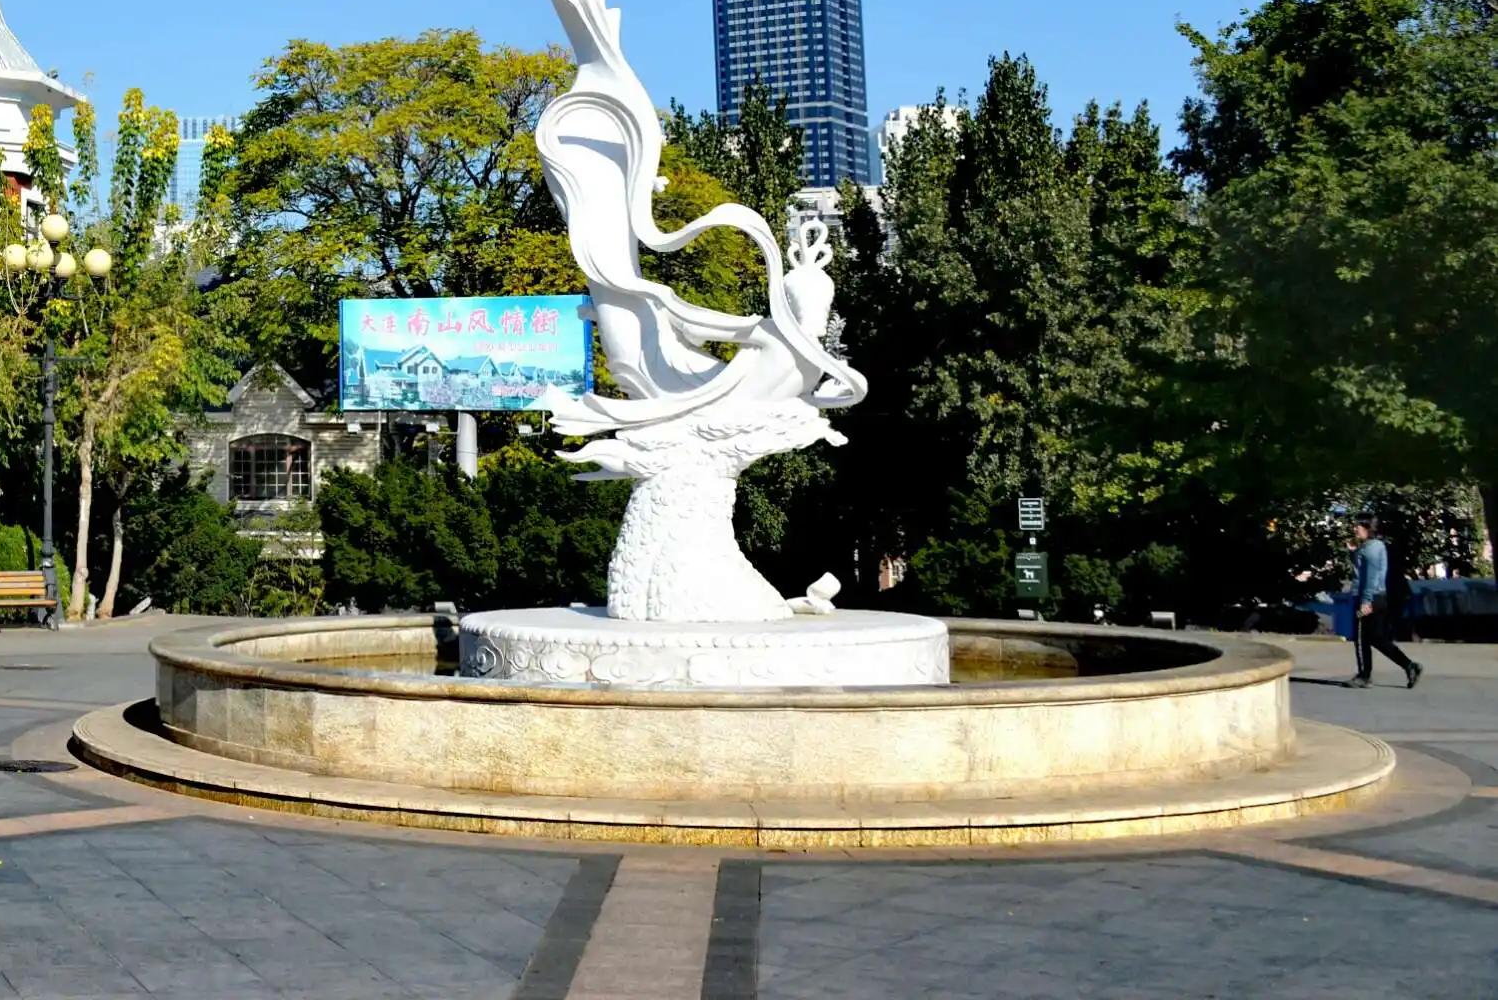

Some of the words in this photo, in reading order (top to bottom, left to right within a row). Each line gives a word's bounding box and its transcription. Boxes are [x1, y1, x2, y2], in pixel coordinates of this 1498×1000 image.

[361, 306, 559, 336] 大连南山风情街
